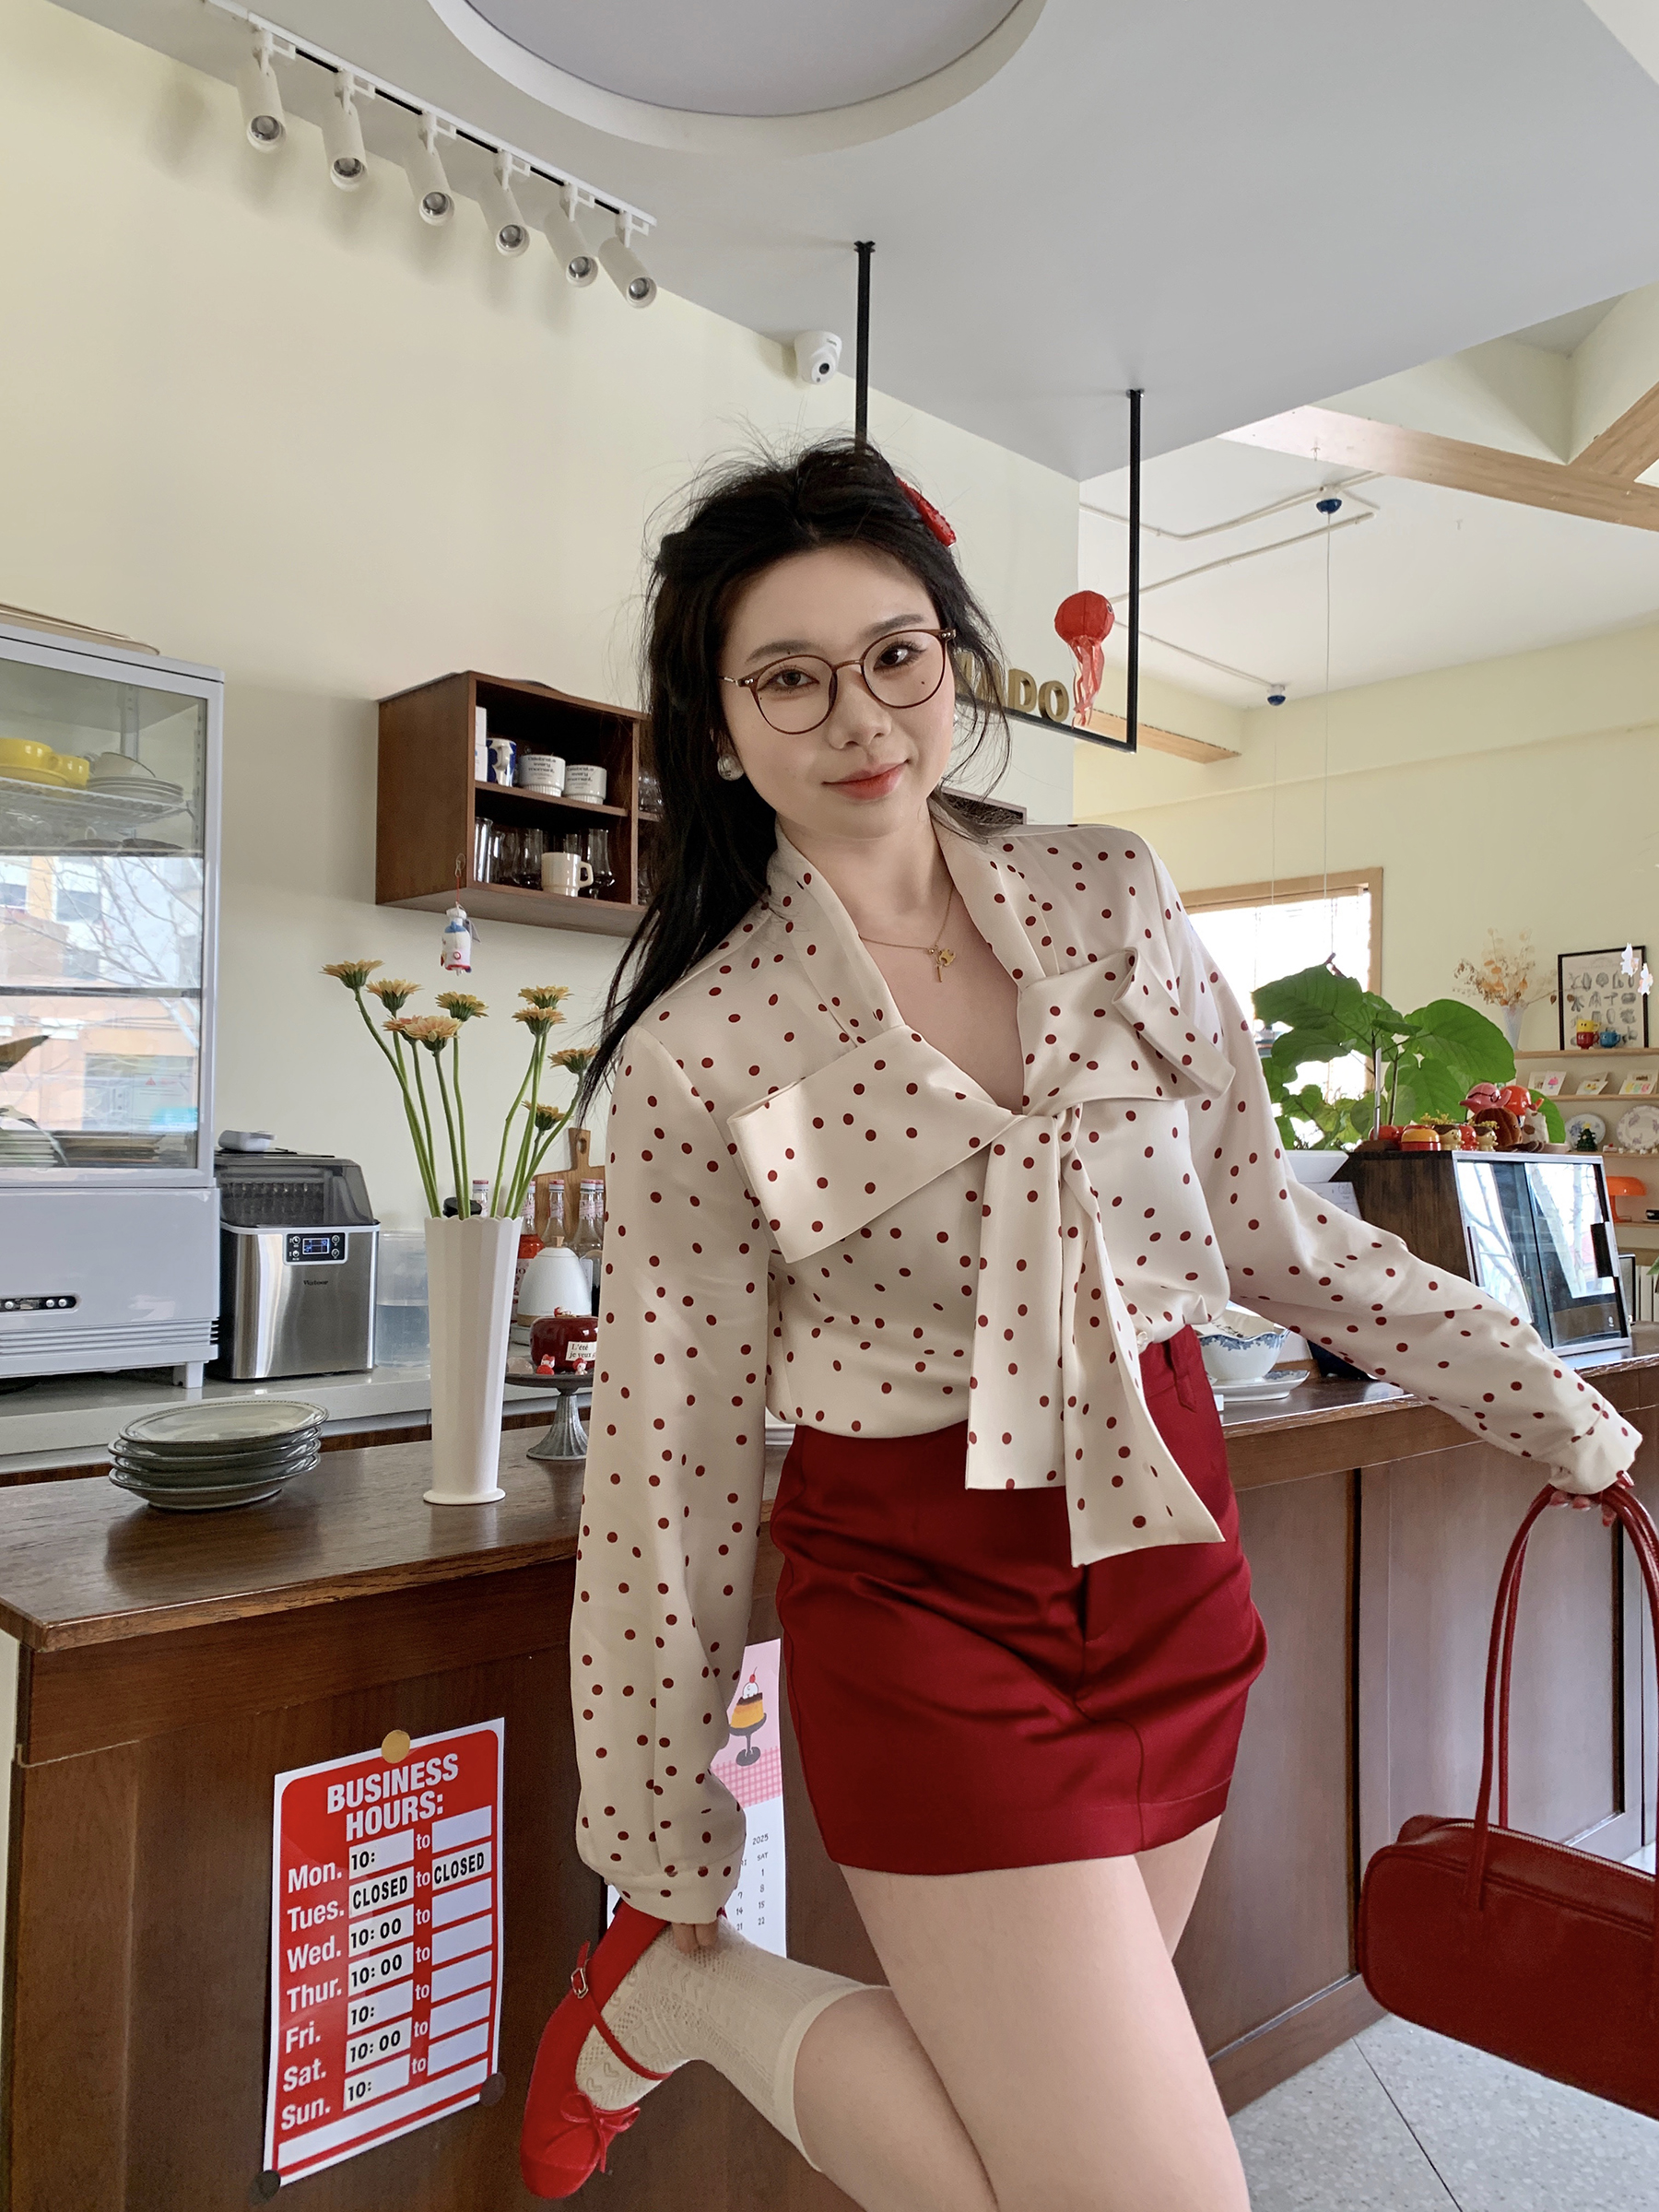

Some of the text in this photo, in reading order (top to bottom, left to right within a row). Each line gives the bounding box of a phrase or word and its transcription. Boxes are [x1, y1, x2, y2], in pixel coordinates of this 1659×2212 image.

[327, 1754, 459, 1814] BUSINESS
[346, 1794, 443, 1841] HOURS:
[752, 1833, 769, 1845] 2025
[288, 1833, 430, 1893] Mon. 10: to
[757, 1852, 769, 1862] SAT
[287, 1852, 485, 1933] Tues. CLOSED to CLOSED
[759, 1900, 765, 1909] 15
[759, 1917, 765, 1925] 22
[287, 1937, 342, 1972] Wed.
[416, 1909, 430, 1925] to
[287, 1976, 342, 2013] Thur.
[416, 1946, 430, 1961] to
[286, 1983, 429, 2053] Fri. 10: to
[283, 2058, 326, 2092] Sat.
[414, 2020, 429, 2037] to
[281, 2057, 426, 2131] Sun. 10: to
